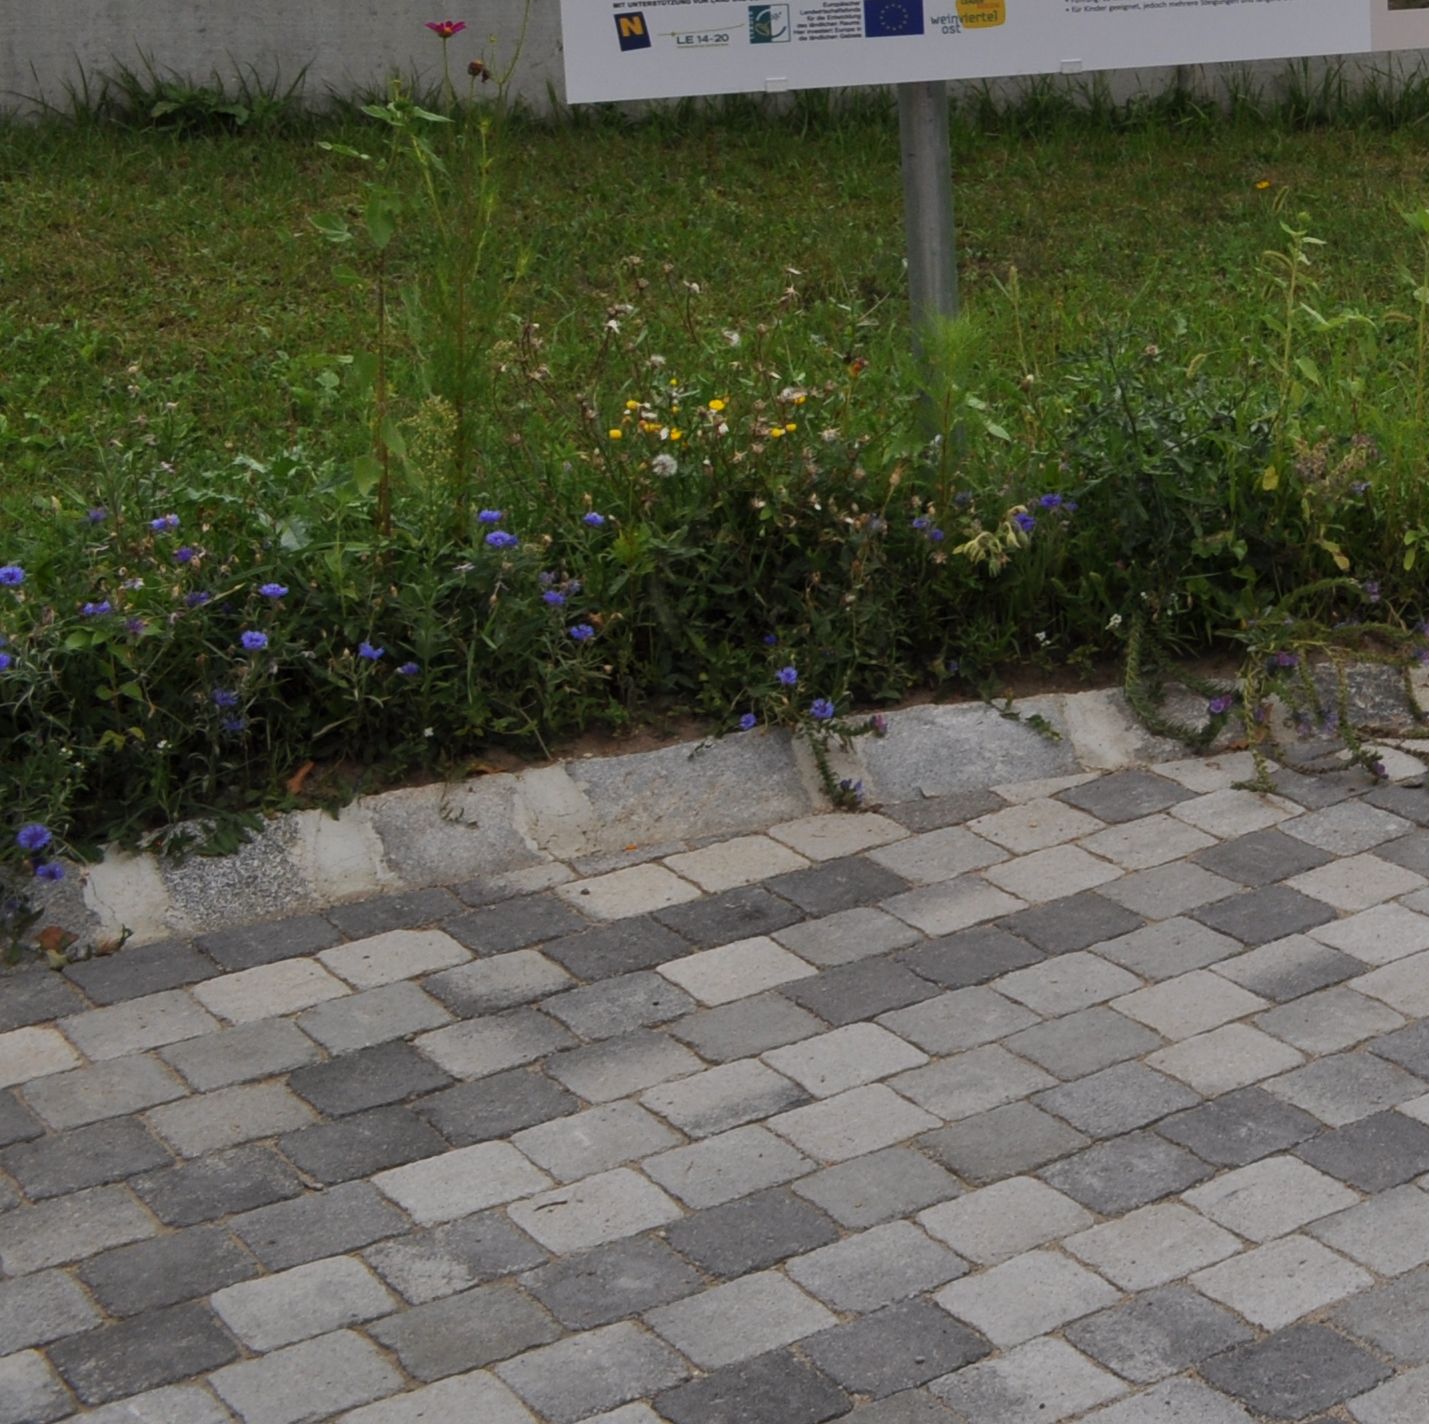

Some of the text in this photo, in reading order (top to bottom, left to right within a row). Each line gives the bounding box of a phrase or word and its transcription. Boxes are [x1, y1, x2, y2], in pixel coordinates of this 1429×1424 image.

[628, 0, 691, 8] UNTERSTÜTZUNG
[931, 10, 998, 26] weinviertel
[619, 16, 644, 37] N
[942, 25, 961, 35] ost
[677, 36, 694, 45] LE
